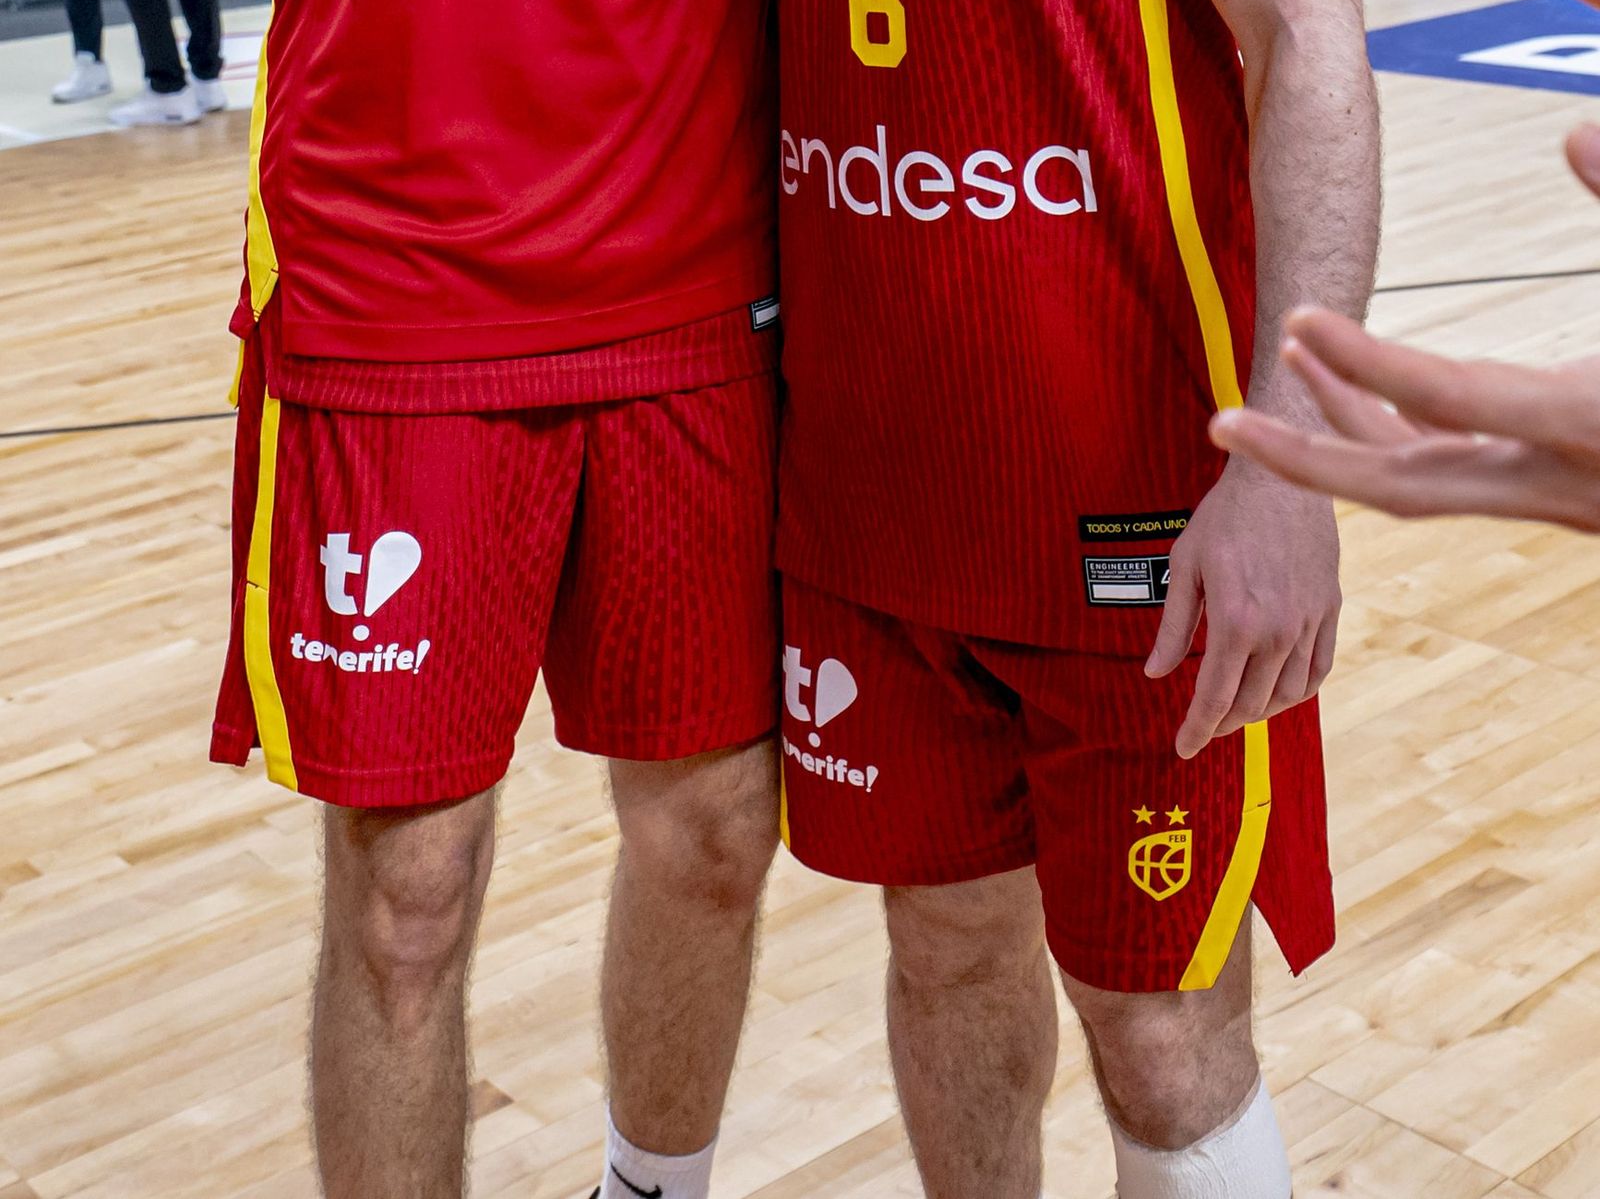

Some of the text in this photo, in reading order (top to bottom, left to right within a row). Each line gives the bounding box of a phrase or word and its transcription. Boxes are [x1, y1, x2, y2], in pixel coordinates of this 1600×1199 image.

[781, 124, 1098, 221] endesa
[1086, 519, 1187, 533] TODOS Y CADA UNO
[1089, 562, 1148, 571] ENGINEERED
[1168, 834, 1187, 843] FEB
